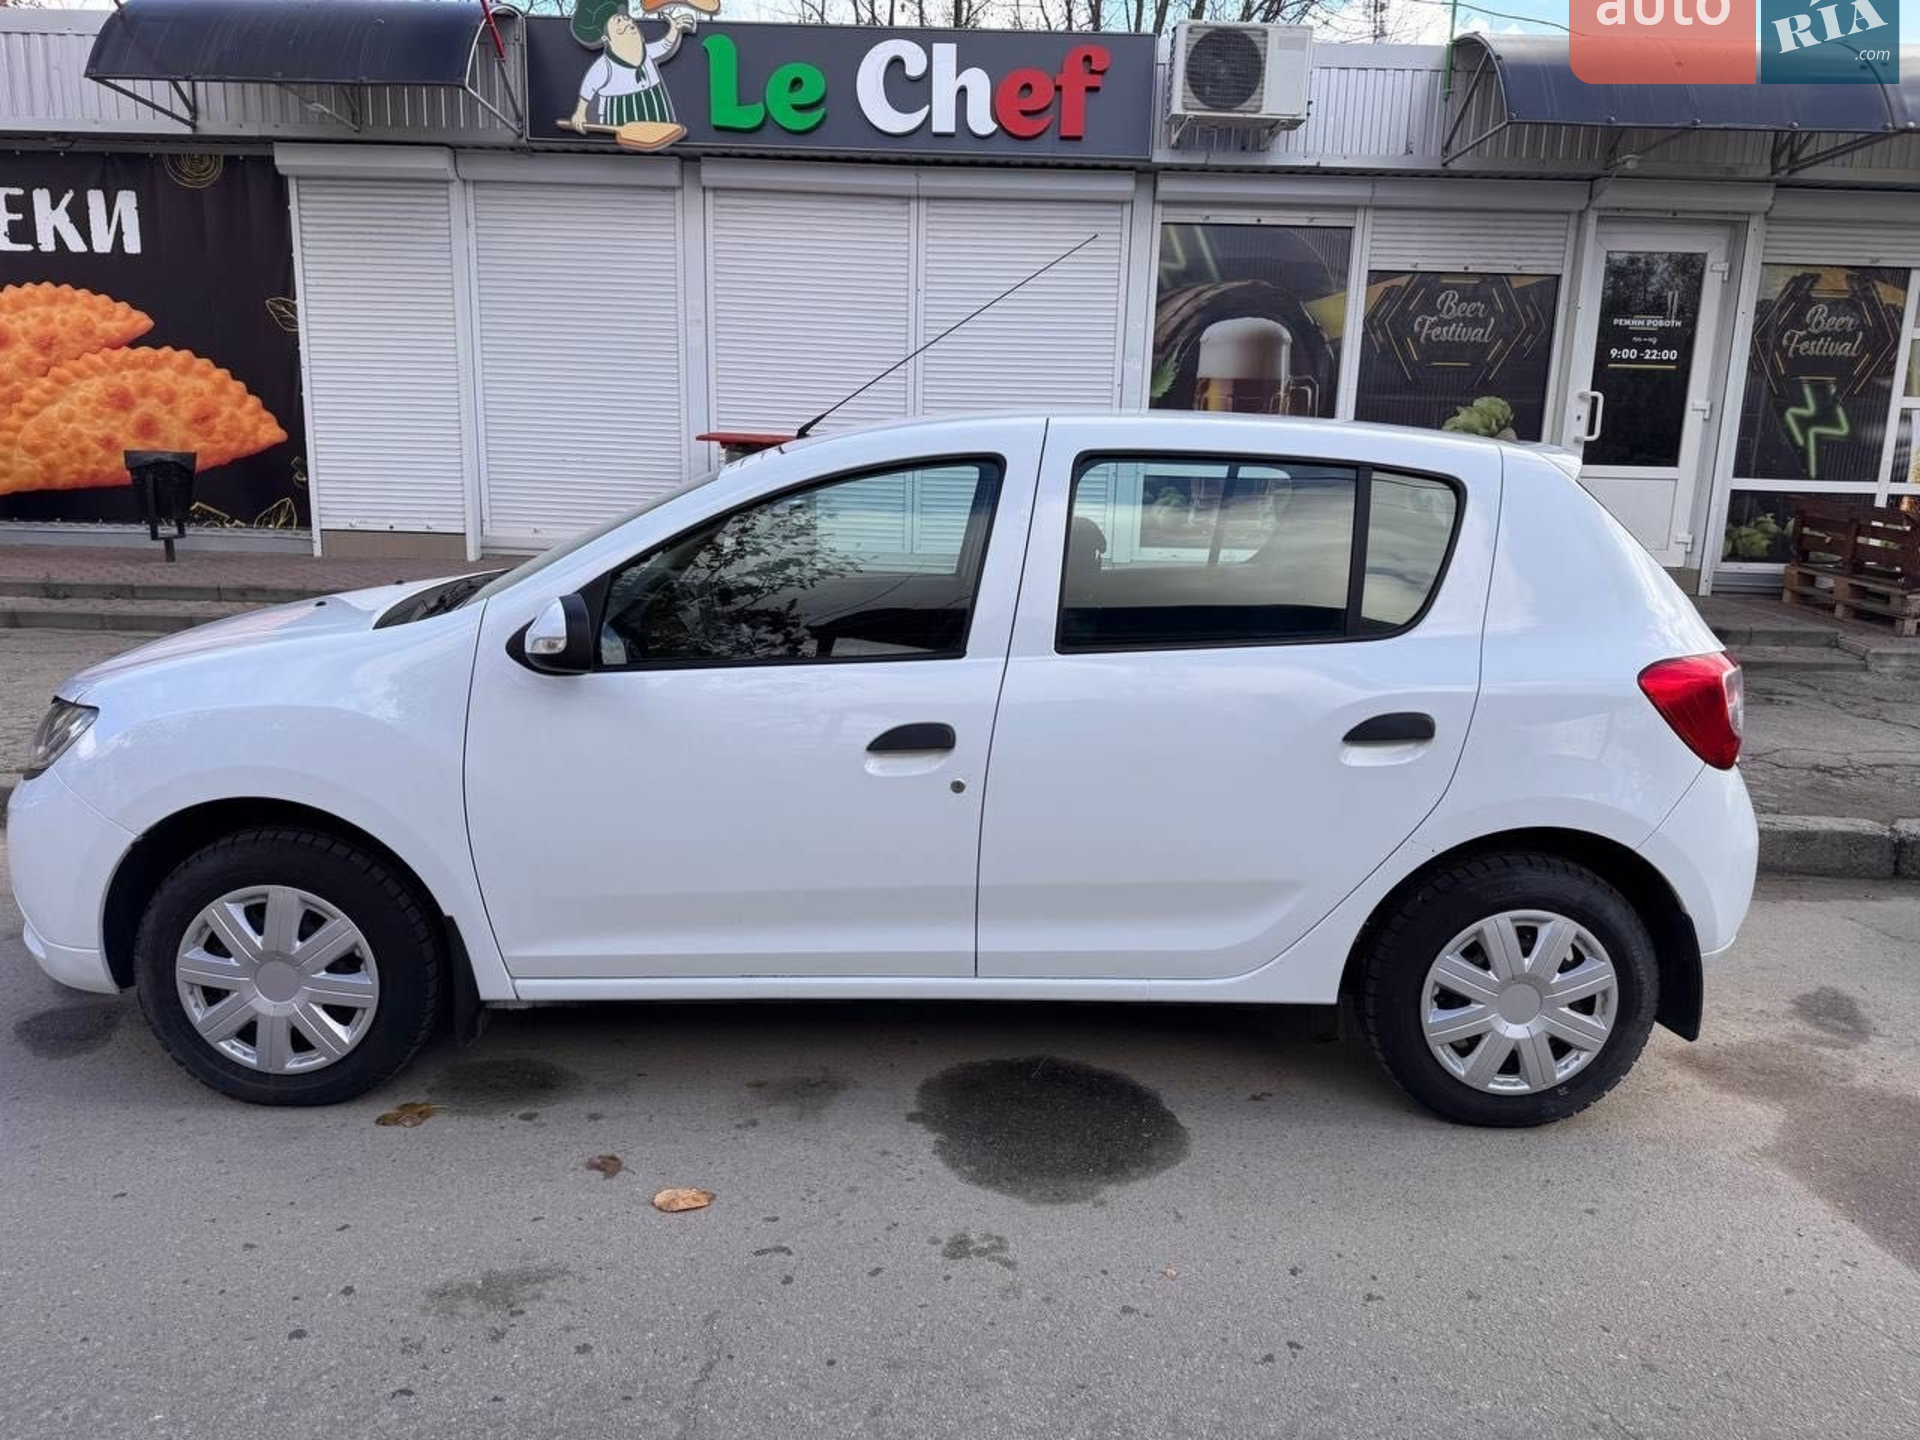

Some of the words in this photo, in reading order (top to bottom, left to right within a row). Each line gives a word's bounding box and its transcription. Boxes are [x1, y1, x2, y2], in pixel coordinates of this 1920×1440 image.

[702, 33, 827, 133] Le
[856, 38, 1112, 141] Chef
[1436, 289, 1487, 320] Beer
[1805, 304, 1858, 334] Beer
[1413, 314, 1496, 345] Festival
[1613, 317, 1646, 327] РЕЖИМ
[1781, 329, 1863, 359] Festival
